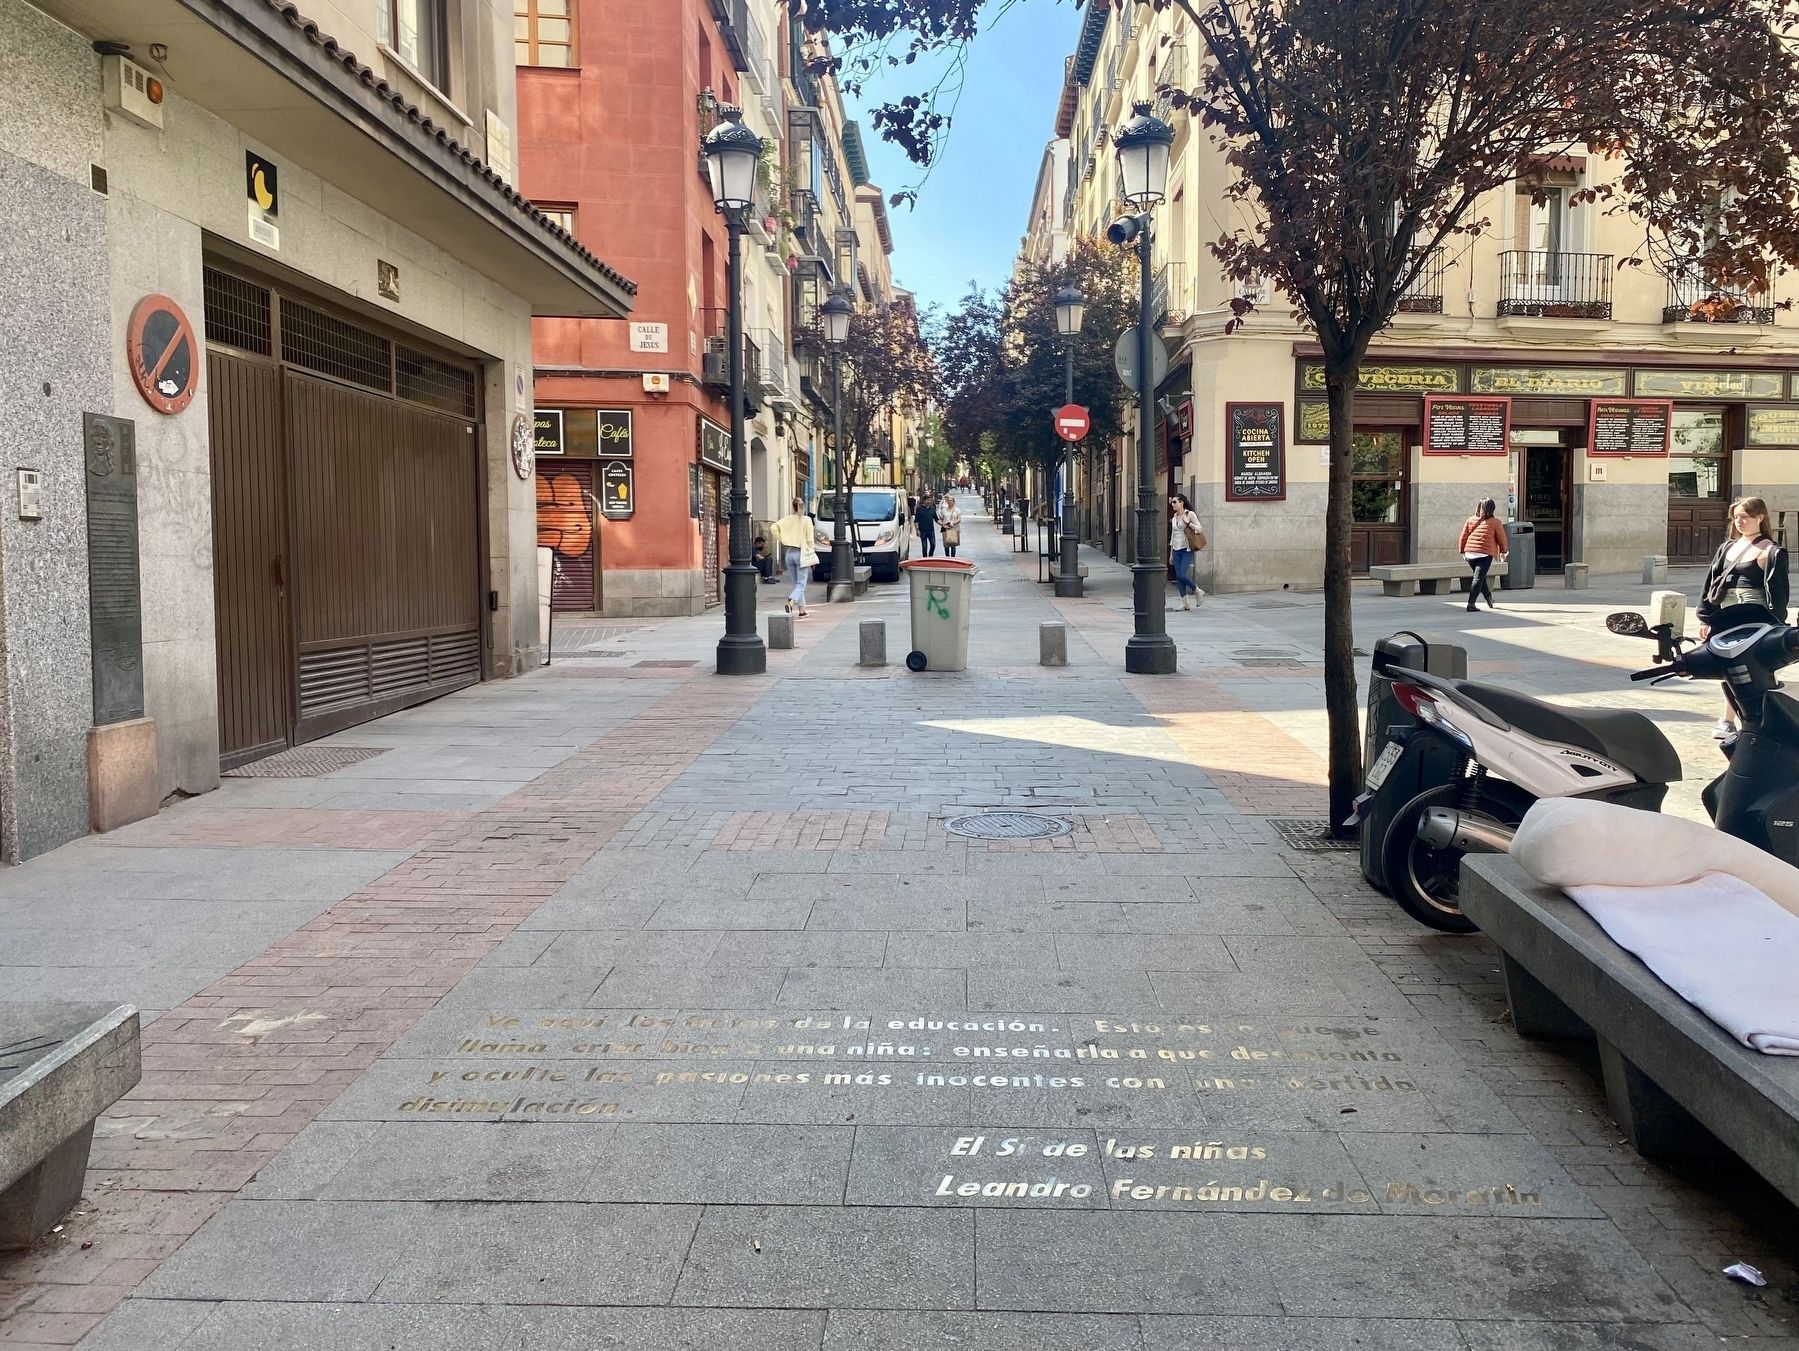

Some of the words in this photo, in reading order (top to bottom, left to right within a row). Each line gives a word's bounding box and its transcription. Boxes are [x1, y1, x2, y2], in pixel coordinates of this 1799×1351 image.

[638, 325, 660, 334] CALLE
[1315, 372, 1448, 385] CVECERIA
[1528, 378, 1603, 389] DIARIO
[533, 416, 552, 429] pas
[534, 436, 558, 448] oteca
[600, 423, 630, 443] Cafés
[1241, 434, 1271, 442] ABIERTA
[1560, 749, 1599, 763] AGILITY
[1599, 760, 1618, 772] CITY
[624, 1014, 675, 1028] los
[795, 1016, 832, 1030] de
[843, 1016, 871, 1030] la
[1095, 1020, 1163, 1034] Esto
[456, 1039, 548, 1053] llama
[570, 1041, 647, 1054] criar
[777, 1043, 836, 1055] una
[953, 1045, 1120, 1060] enseñarla
[1129, 1050, 1147, 1059] a
[1157, 1050, 1217, 1063] que
[427, 1071, 448, 1084] y
[583, 1067, 634, 1084] las
[652, 1071, 811, 1087] pasiones
[823, 1069, 892, 1086] más
[915, 1072, 1086, 1088] inocentes
[1105, 1076, 1167, 1089] con
[950, 1136, 984, 1157] El
[1042, 1141, 1088, 1158] de
[1105, 1138, 1155, 1160] las
[1169, 1140, 1267, 1160] niñas
[935, 1174, 1094, 1199] Leandro
[1107, 1178, 1311, 1204] Fernández
[1322, 1180, 1370, 1205] de
